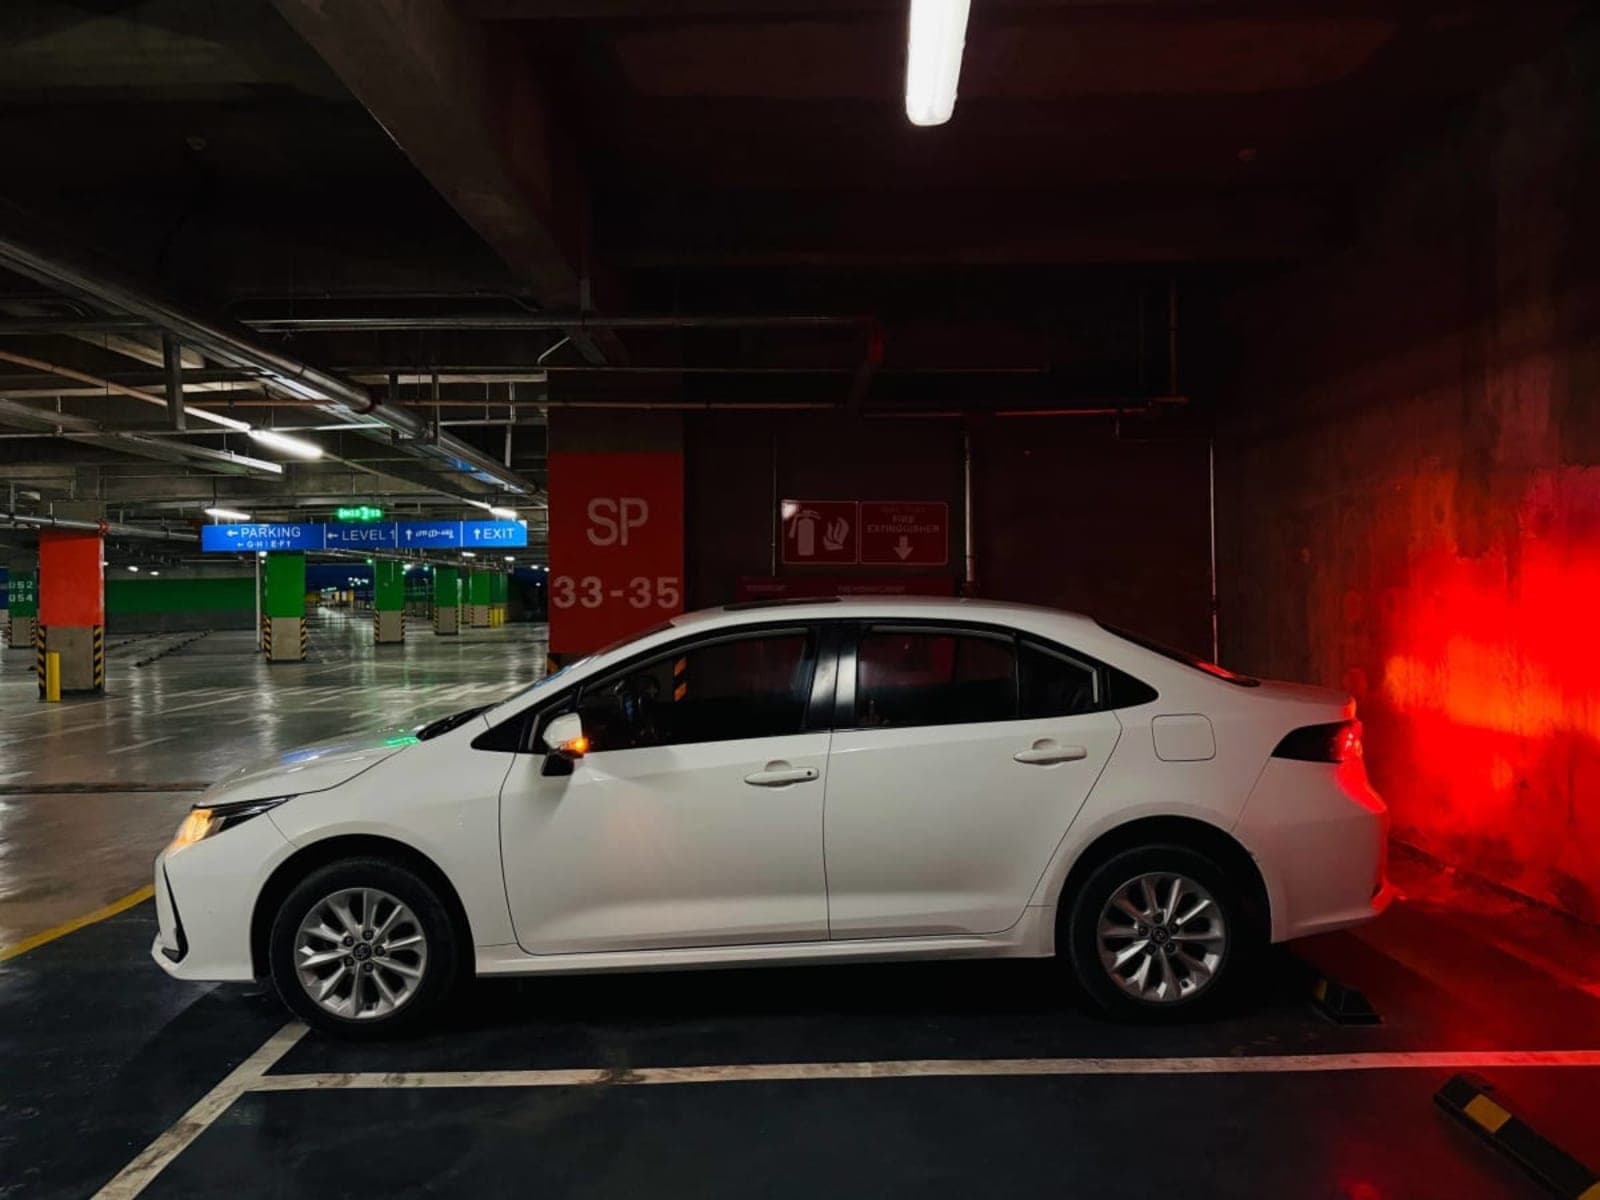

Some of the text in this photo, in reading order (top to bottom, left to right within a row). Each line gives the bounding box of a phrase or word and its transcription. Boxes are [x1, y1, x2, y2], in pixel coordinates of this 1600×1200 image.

[586, 497, 649, 546] SP
[240, 526, 301, 538] PARKING
[341, 529, 386, 541] LEVEL
[483, 527, 515, 540] EXIT
[552, 575, 680, 609] 33-35
